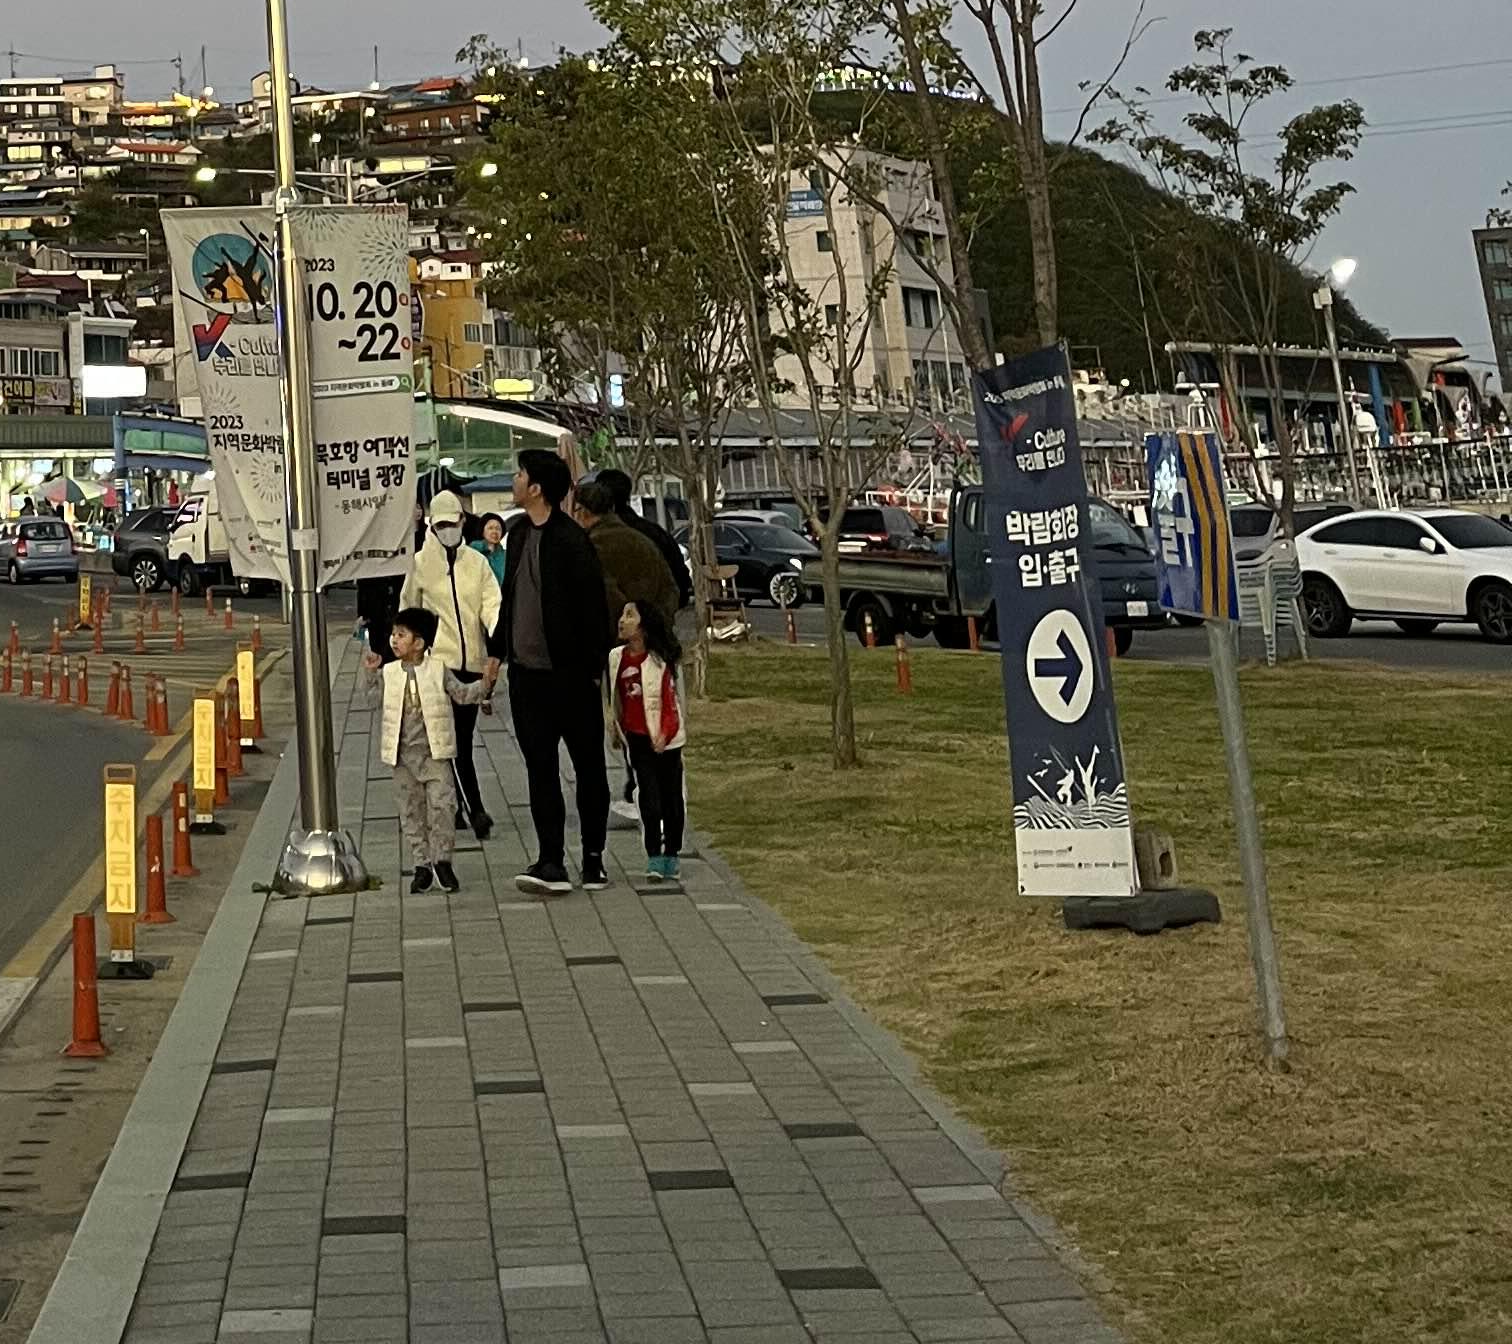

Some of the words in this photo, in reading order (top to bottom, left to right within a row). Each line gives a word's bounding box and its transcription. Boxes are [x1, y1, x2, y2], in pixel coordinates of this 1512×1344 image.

[209, 415, 244, 430] 2023
[362, 436, 409, 460] 여객선
[326, 469, 370, 491] 터미널
[375, 464, 406, 488] 광장
[1005, 503, 1079, 546] 박람회장
